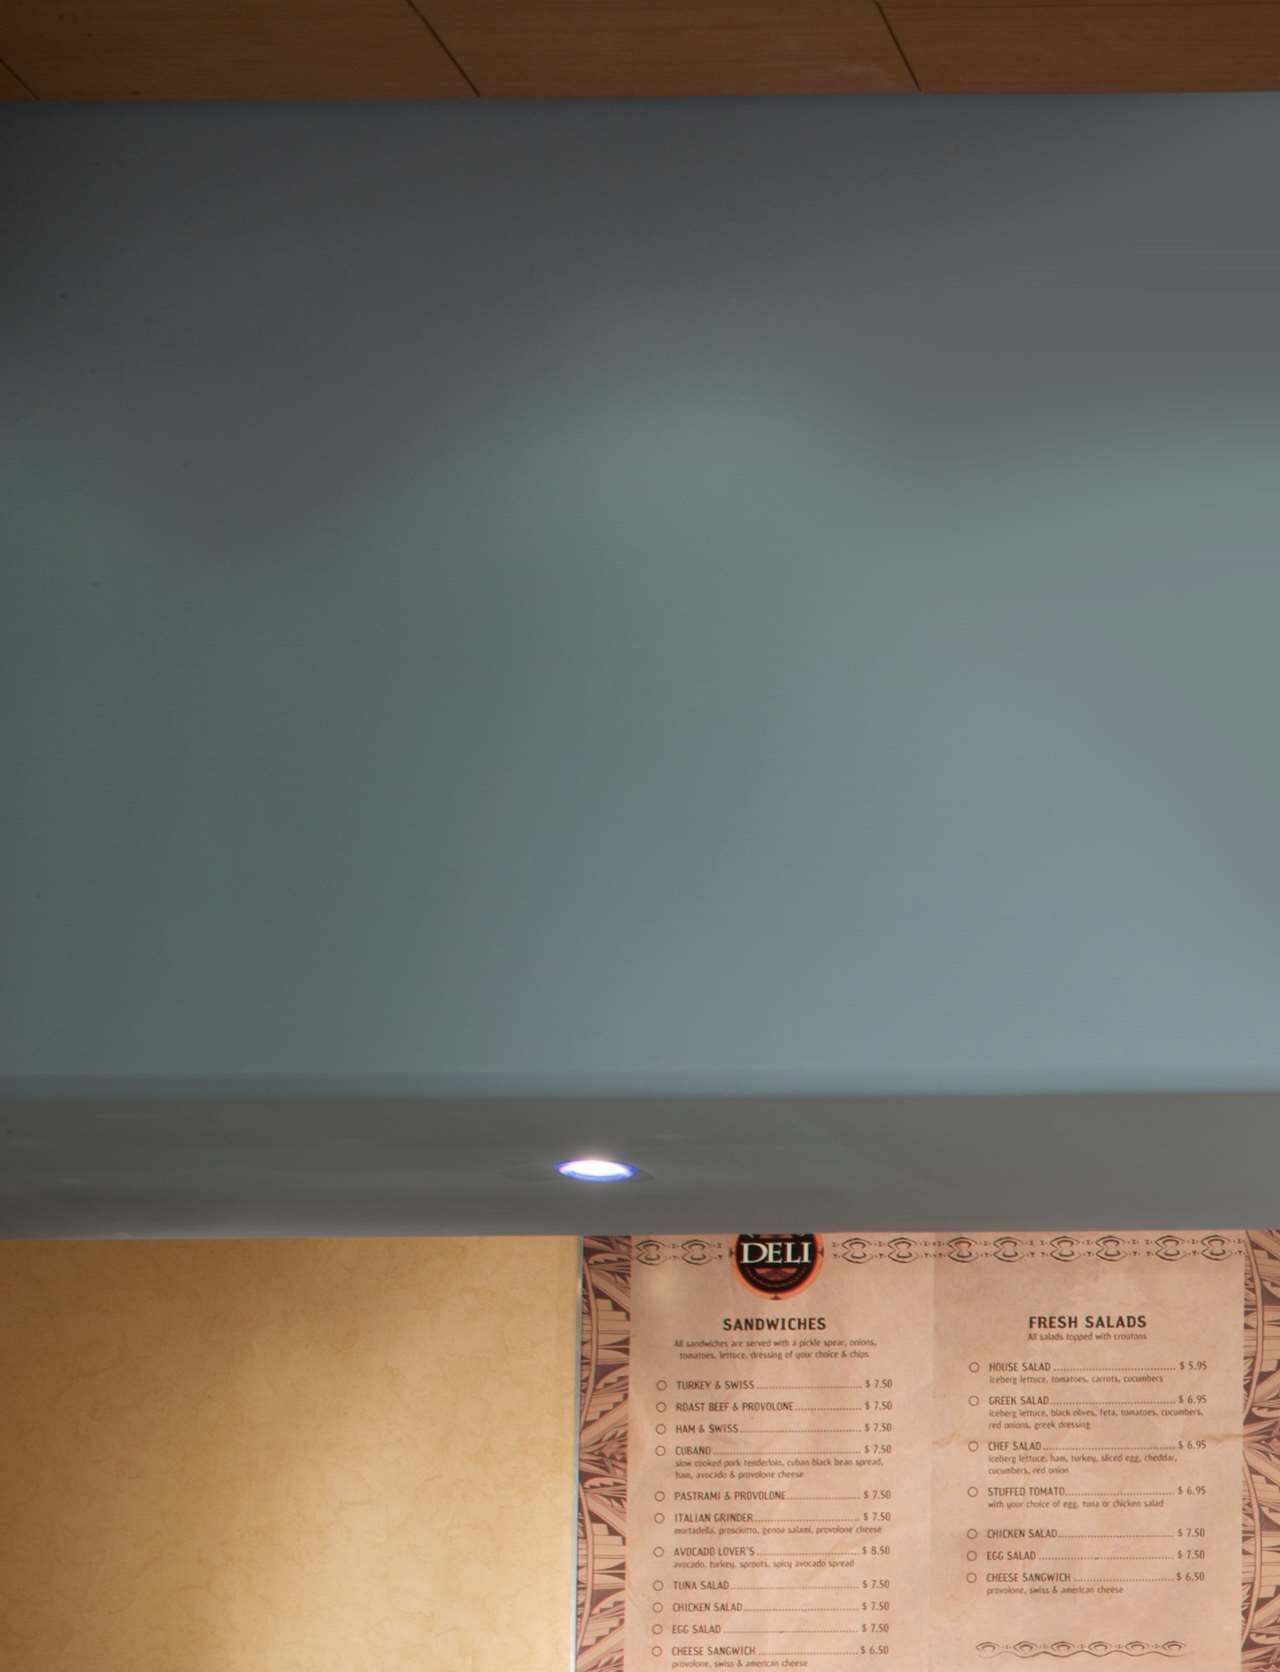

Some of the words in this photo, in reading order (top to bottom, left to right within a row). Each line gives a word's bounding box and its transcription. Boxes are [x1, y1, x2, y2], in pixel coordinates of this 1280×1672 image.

[740, 1241, 812, 1264] DELI
[723, 1317, 826, 1331] SANDWICHES
[1029, 1316, 1078, 1329] FRESH
[1085, 1315, 1147, 1329] SALADS
[989, 1362, 1018, 1372] HOUSE
[1021, 1361, 1051, 1372] SALAD
[1188, 1360, 1208, 1370] 5.95
[676, 1380, 712, 1390] TURKEY
[714, 1380, 722, 1390] &
[724, 1380, 755, 1390] SWISS
[874, 1378, 893, 1389] 7.50
[988, 1395, 1017, 1406] GREEK
[1020, 1395, 1050, 1406] SALAD
[675, 1402, 705, 1412] ROAST
[708, 1402, 729, 1412] BEEF
[732, 1402, 739, 1412] &
[741, 1401, 793, 1412] PROVOLONE
[675, 1424, 696, 1433] HAM
[698, 1424, 705, 1434] &
[708, 1423, 739, 1434] SWISS
[873, 1422, 892, 1433] 7.50
[675, 1445, 712, 1456] CUBANO
[988, 1440, 1010, 1451] CHEF
[1012, 1441, 1042, 1451] SALAD
[674, 1491, 721, 1501] PASTRAMI
[724, 1491, 731, 1501] &
[734, 1490, 786, 1501] PROVOLONE
[987, 1487, 1026, 1497] STUFFED
[1028, 1486, 1067, 1497] TOMATO
[1186, 1485, 1206, 1495] 6.95
[674, 1513, 711, 1523] ITALIAN
[713, 1512, 754, 1523] GRINDER
[986, 1528, 1026, 1539] CHICKEN
[1028, 1528, 1058, 1539] SALAD
[673, 1546, 716, 1557] AVOCADO
[870, 1545, 890, 1556] 8.50
[986, 1550, 1004, 1561] EGG
[1006, 1550, 1036, 1561] SALAD
[986, 1572, 1019, 1583] CHEESE
[673, 1580, 698, 1590] TUNA
[700, 1580, 730, 1590] SALAD
[672, 1602, 711, 1613] CHICKEN
[713, 1602, 743, 1612] SALAD
[671, 1624, 689, 1634] EGG
[692, 1624, 721, 1634] SALAD
[671, 1646, 704, 1656] CHEESE
[869, 1645, 889, 1655] 6.50
